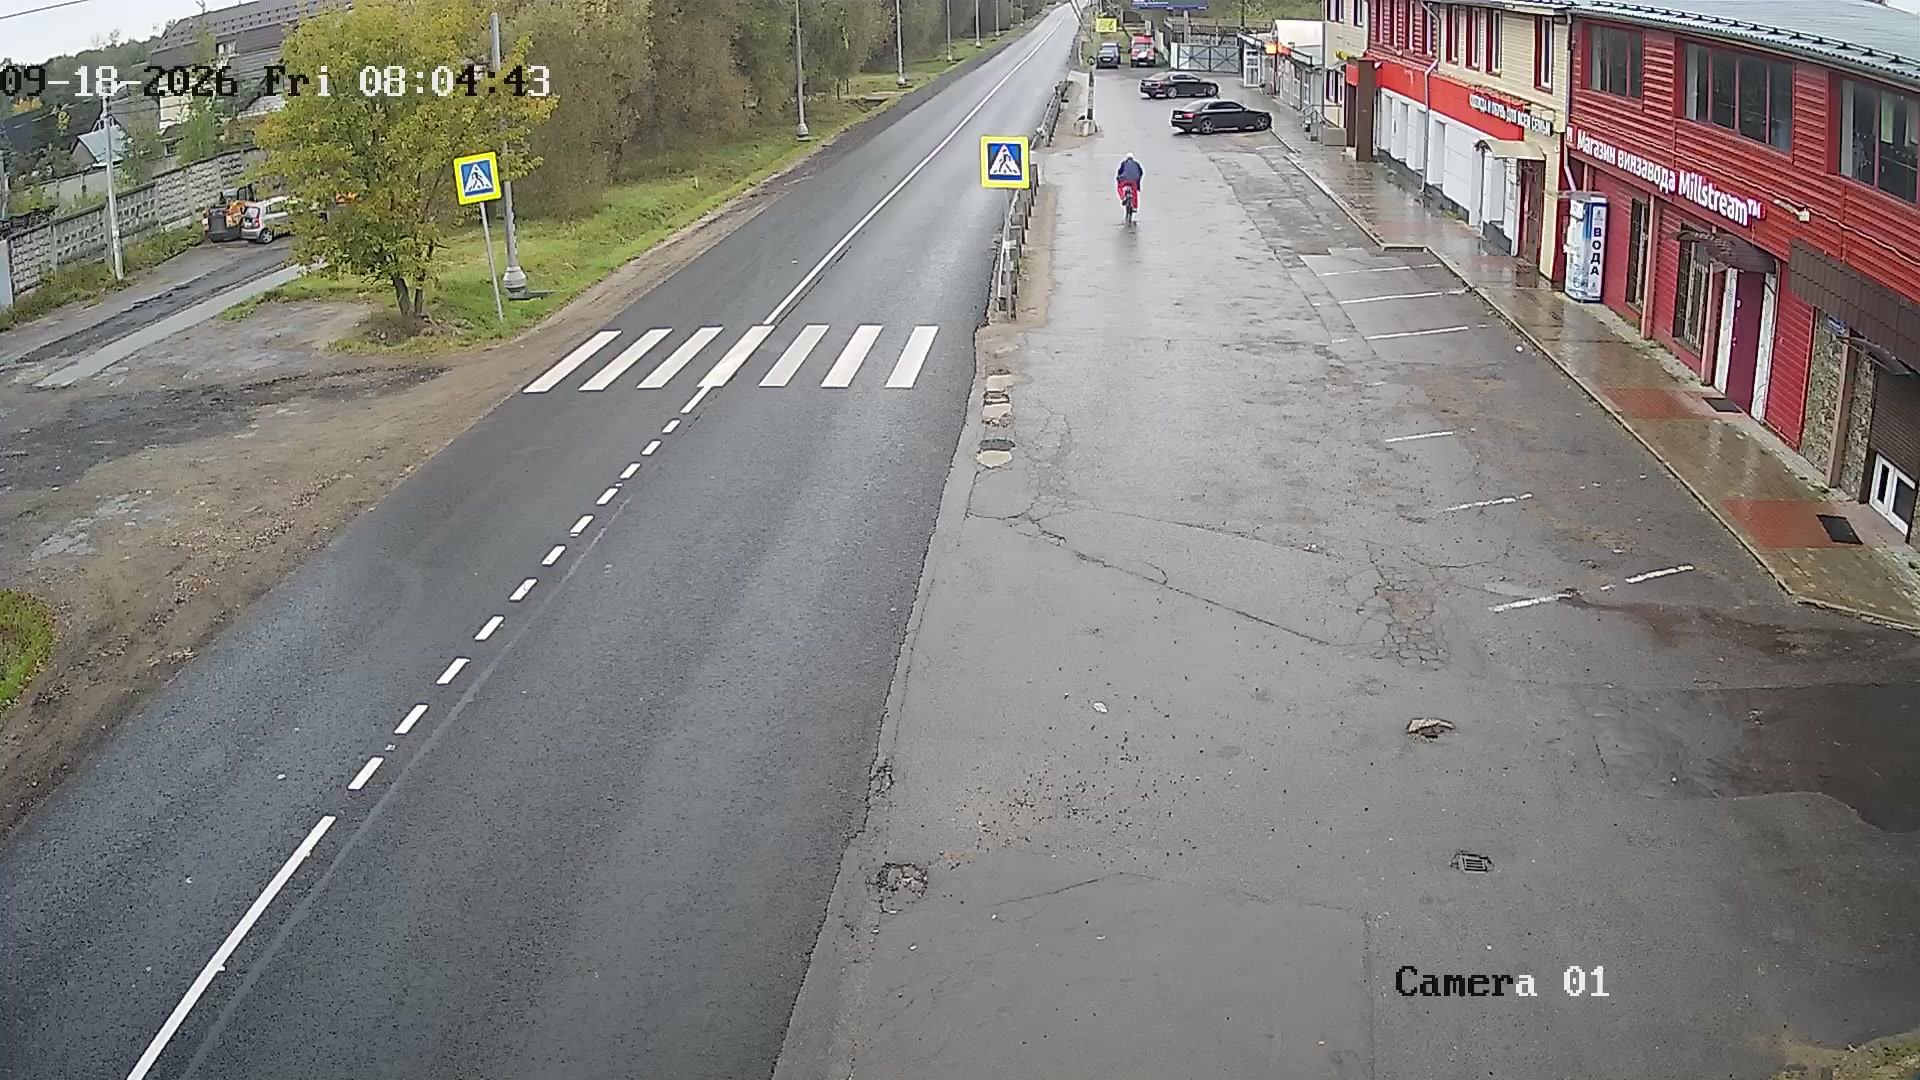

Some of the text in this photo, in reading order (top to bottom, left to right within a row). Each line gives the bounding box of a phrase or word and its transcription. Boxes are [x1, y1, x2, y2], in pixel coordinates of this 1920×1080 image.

[1577, 128, 1616, 165] Магазин
[1618, 149, 1676, 194] винзавода
[1590, 227, 1602, 276] ВОДА
